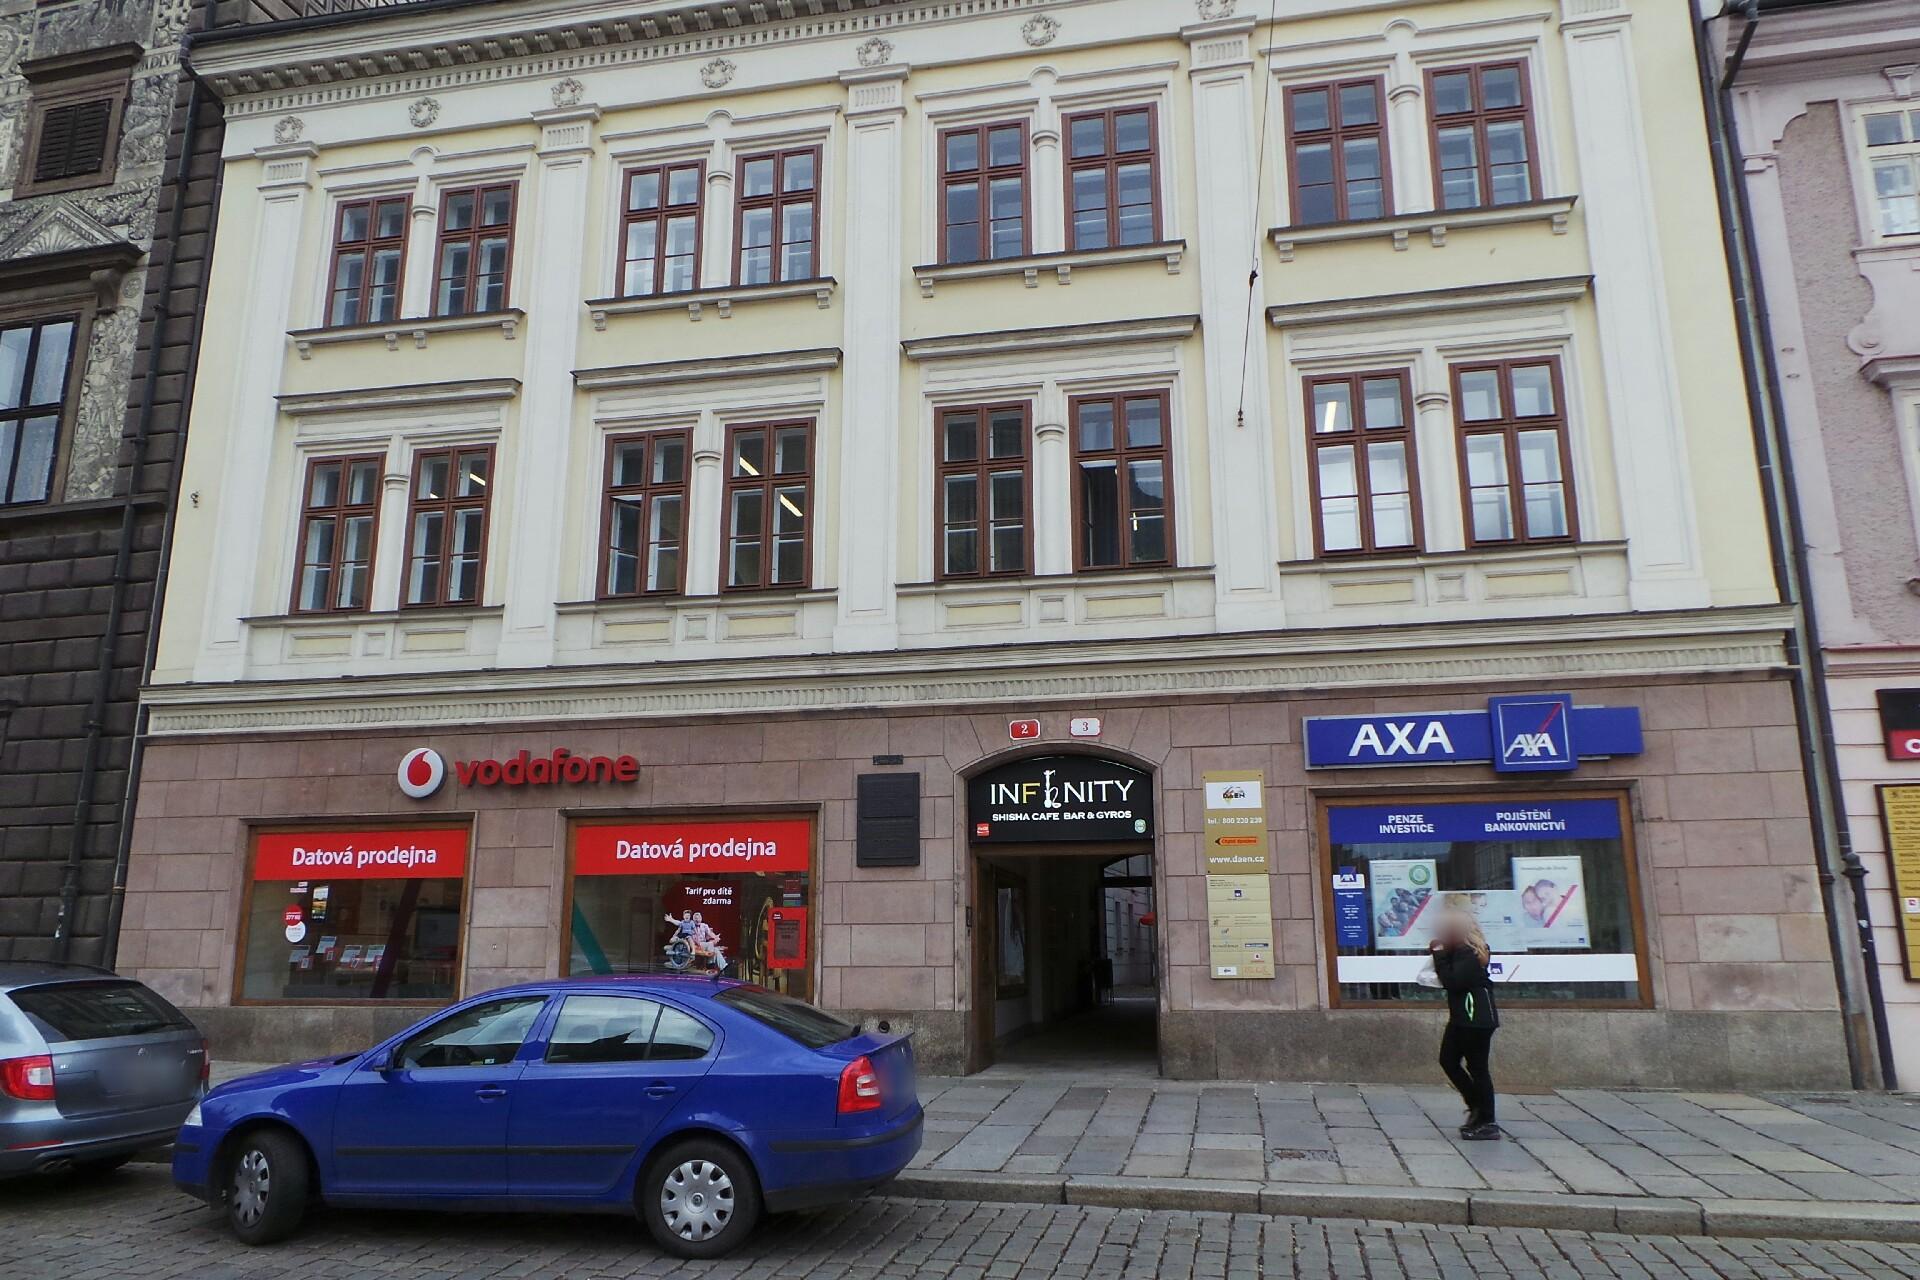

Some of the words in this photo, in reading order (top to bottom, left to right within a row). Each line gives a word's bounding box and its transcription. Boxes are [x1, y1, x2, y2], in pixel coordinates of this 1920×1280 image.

[1021, 724, 1029, 735] 2
[1082, 722, 1089, 731] 3
[1349, 721, 1455, 757] AXA
[1505, 733, 1558, 757] AXA
[454, 747, 638, 786] vodafone
[992, 813, 1030, 822] SHISHA
[1031, 812, 1060, 821] CAFE
[1063, 812, 1086, 820] BAR
[1087, 811, 1095, 820] &
[1096, 810, 1132, 819] GYROS
[1388, 814, 1424, 824] PENZE
[1496, 809, 1551, 821] POJIŠTĚNÍ
[1379, 823, 1435, 834] INVESTICE
[1484, 819, 1566, 833] BANKOVNICTVÍ
[616, 838, 684, 859] Datová
[689, 838, 777, 862] prodejna
[292, 846, 353, 866] Datová
[357, 846, 437, 868] prodejna
[1209, 855, 1265, 864] www.daen.cz
[685, 886, 702, 896] Tarif
[703, 889, 716, 897] pro
[717, 887, 732, 896] dítě
[703, 897, 732, 905] zdarma
